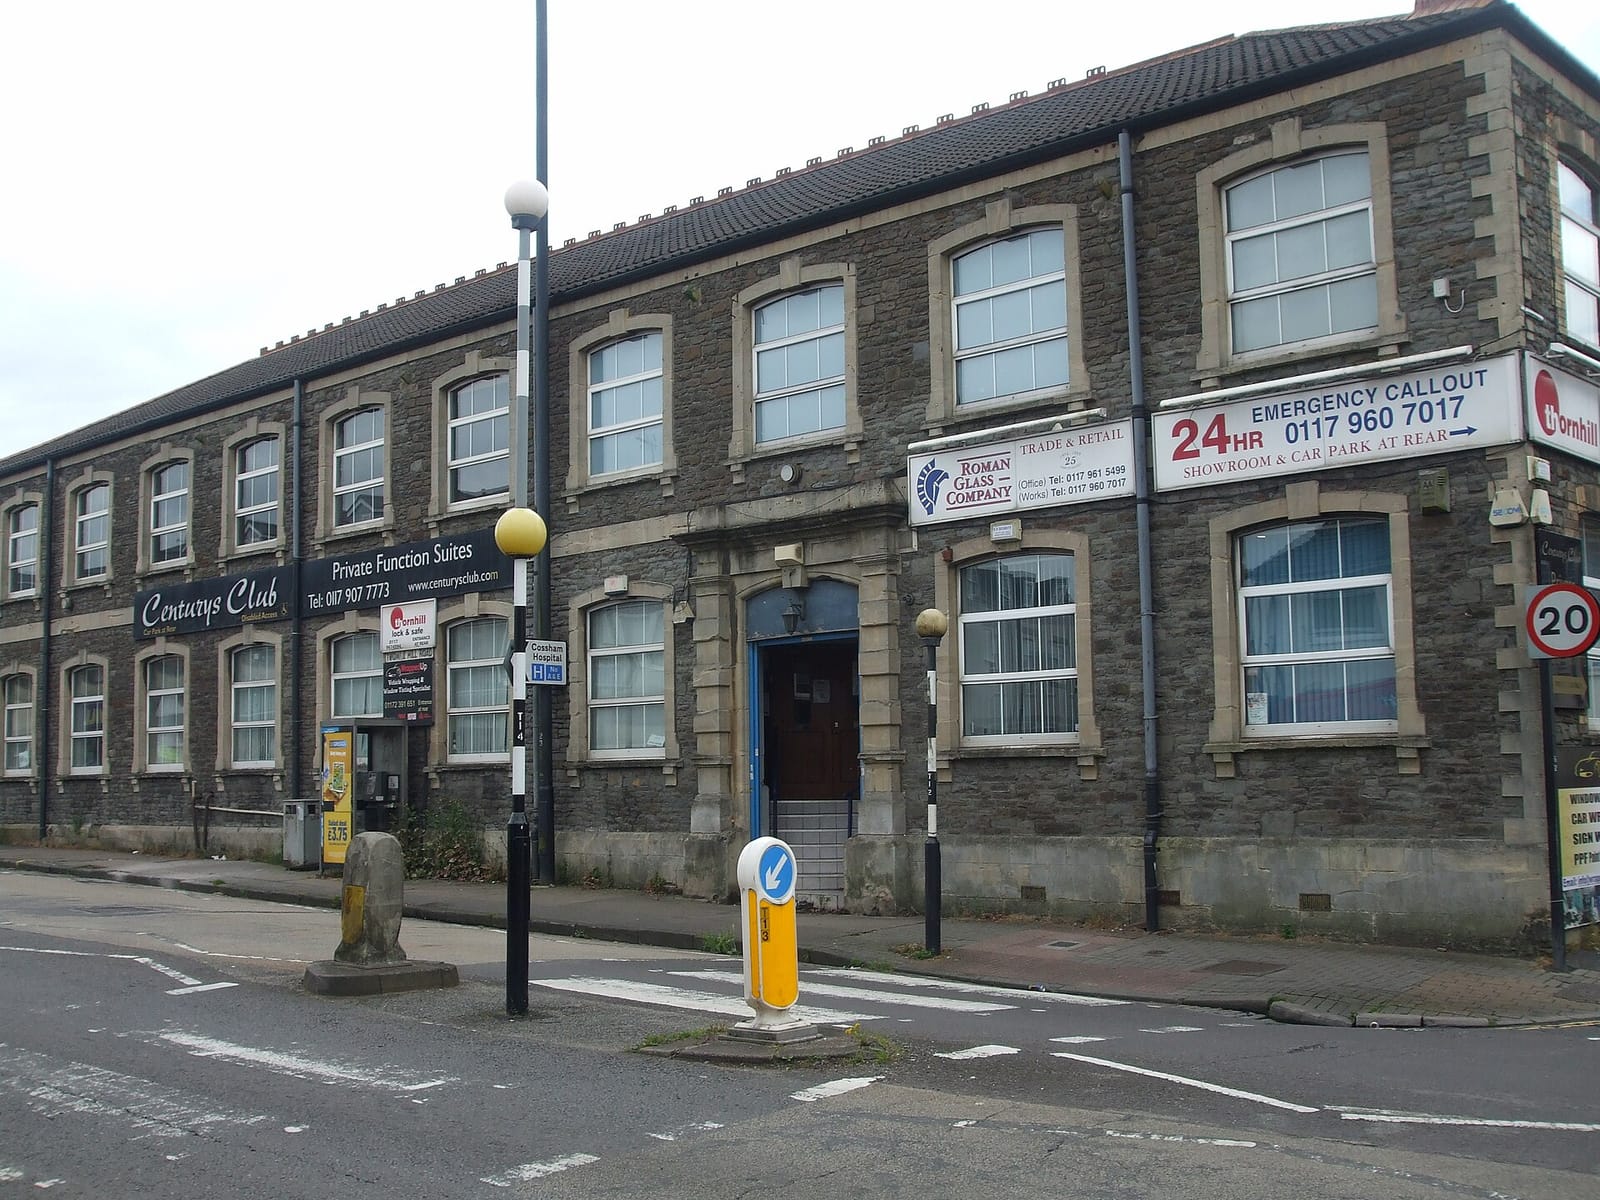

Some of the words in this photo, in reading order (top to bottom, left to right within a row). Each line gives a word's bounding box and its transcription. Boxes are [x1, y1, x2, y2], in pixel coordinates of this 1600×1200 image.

[1253, 387, 1377, 423] EMERGENCY
[1385, 369, 1488, 401] CALLOUT
[1285, 414, 1339, 444] 0117
[1348, 406, 1393, 434] 960
[1402, 395, 1465, 425] 7017
[1544, 403, 1598, 447] thornhill
[1020, 438, 1062, 455] TRADE
[1066, 438, 1074, 448] &
[1078, 428, 1124, 446] RETAIL
[1183, 454, 1272, 479] SHOWROOM
[1276, 454, 1287, 465] &
[1291, 447, 1322, 463] CAR
[1328, 440, 1371, 457] PARK
[1378, 436, 1398, 450] AT
[1404, 429, 1448, 447] REAR
[961, 458, 1011, 476] ROMAN
[1064, 456, 1077, 466] 25
[953, 474, 994, 491] GLASS
[1018, 477, 1047, 489] (Office)
[1049, 475, 1064, 485] Tel:
[1066, 471, 1085, 483] 0117
[1087, 468, 1102, 479] 961
[1105, 464, 1126, 476] 5499
[946, 485, 1012, 505] COMPANY
[1018, 489, 1049, 502] (Works)
[1051, 487, 1066, 497] Tel:
[1068, 484, 1087, 494] 0117
[1089, 480, 1104, 491] 960
[1106, 477, 1126, 489] 7017
[332, 560, 373, 581] Private
[376, 550, 430, 574] Function
[433, 542, 473, 563] Suites
[142, 593, 222, 627] Centurys
[226, 576, 277, 615] Club
[307, 593, 324, 609] Tel:
[325, 590, 342, 607] 0117
[346, 585, 363, 603] 907
[365, 582, 390, 600] 7773
[408, 570, 499, 593] www.centurysclub.com
[391, 629, 404, 638] lock
[411, 626, 424, 635] safe
[1539, 604, 1589, 637] 20
[531, 643, 564, 653] Cossham
[532, 652, 563, 663] Hospital
[1571, 812, 1588, 825] CAR
[1573, 831, 1593, 845] SIGN
[1574, 852, 1588, 866] PPF
